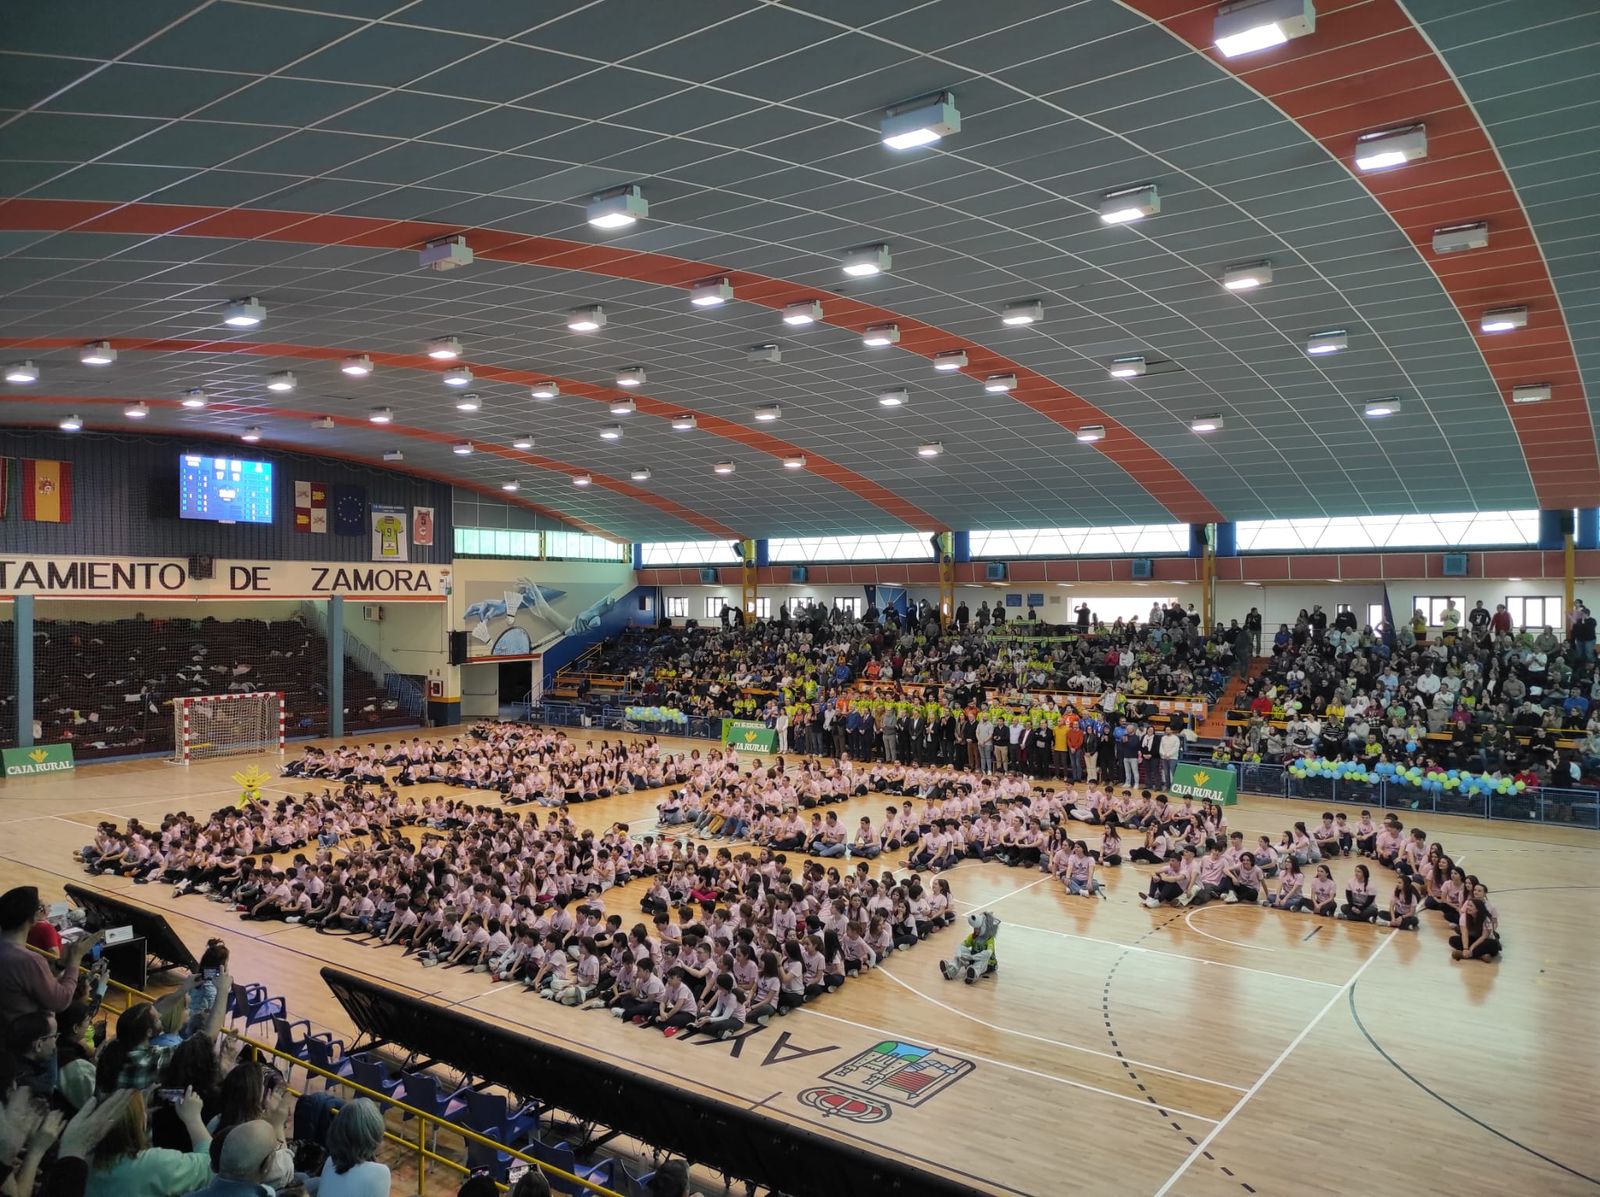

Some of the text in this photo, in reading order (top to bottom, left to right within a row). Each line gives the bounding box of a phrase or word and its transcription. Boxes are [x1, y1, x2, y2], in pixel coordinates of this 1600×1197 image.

[229, 566, 271, 591] DE
[311, 567, 432, 592] ZAMORA
[744, 743, 770, 752] RURAL
[7, 761, 74, 774] CAJA RURAL
[1171, 784, 1224, 801] CAJA RURAL
